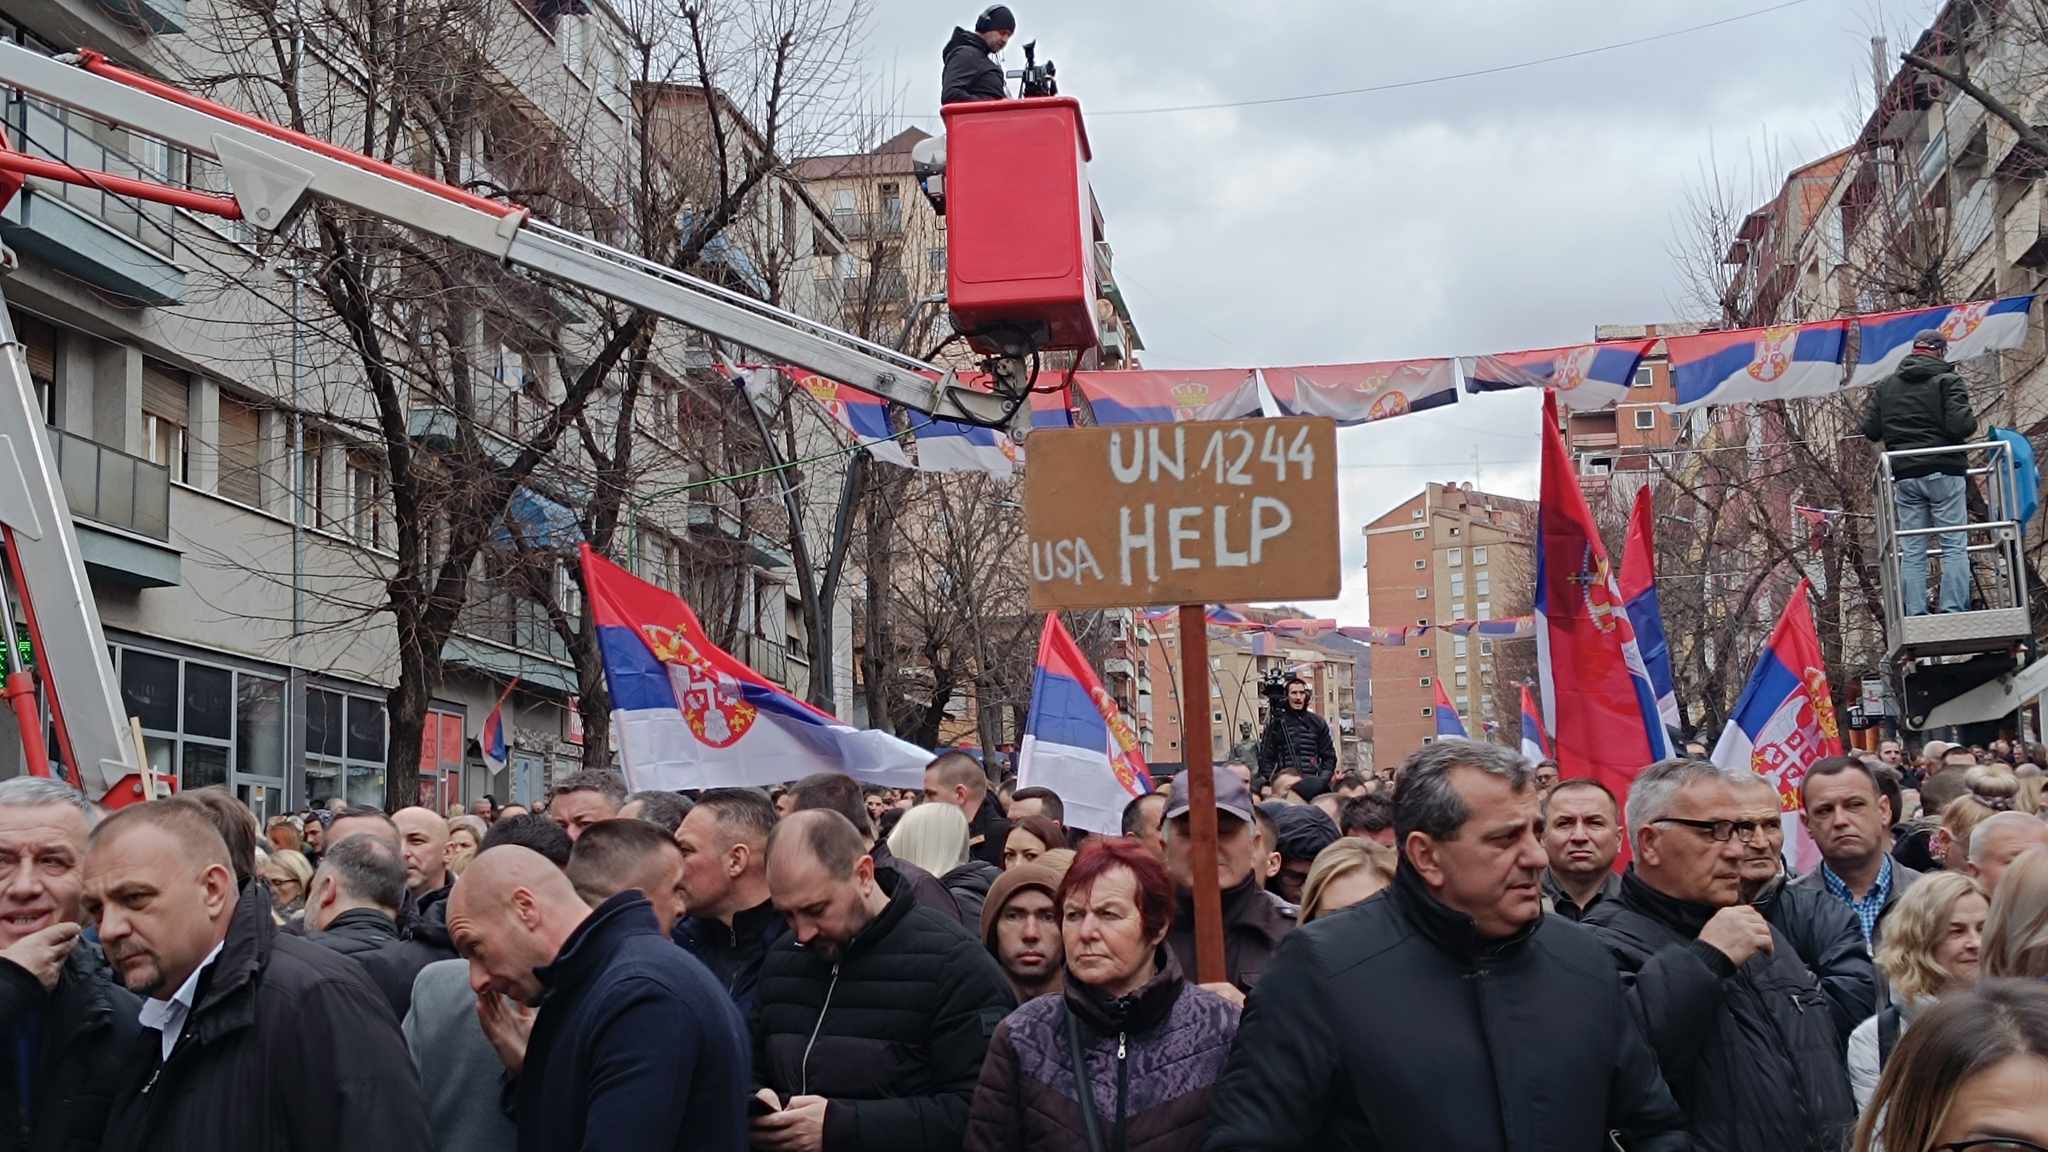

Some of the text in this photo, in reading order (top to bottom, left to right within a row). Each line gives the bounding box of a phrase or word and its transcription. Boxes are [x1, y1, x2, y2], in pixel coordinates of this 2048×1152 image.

[1109, 424, 1315, 485] UN 1244
[1032, 496, 1292, 587] USA HELP
